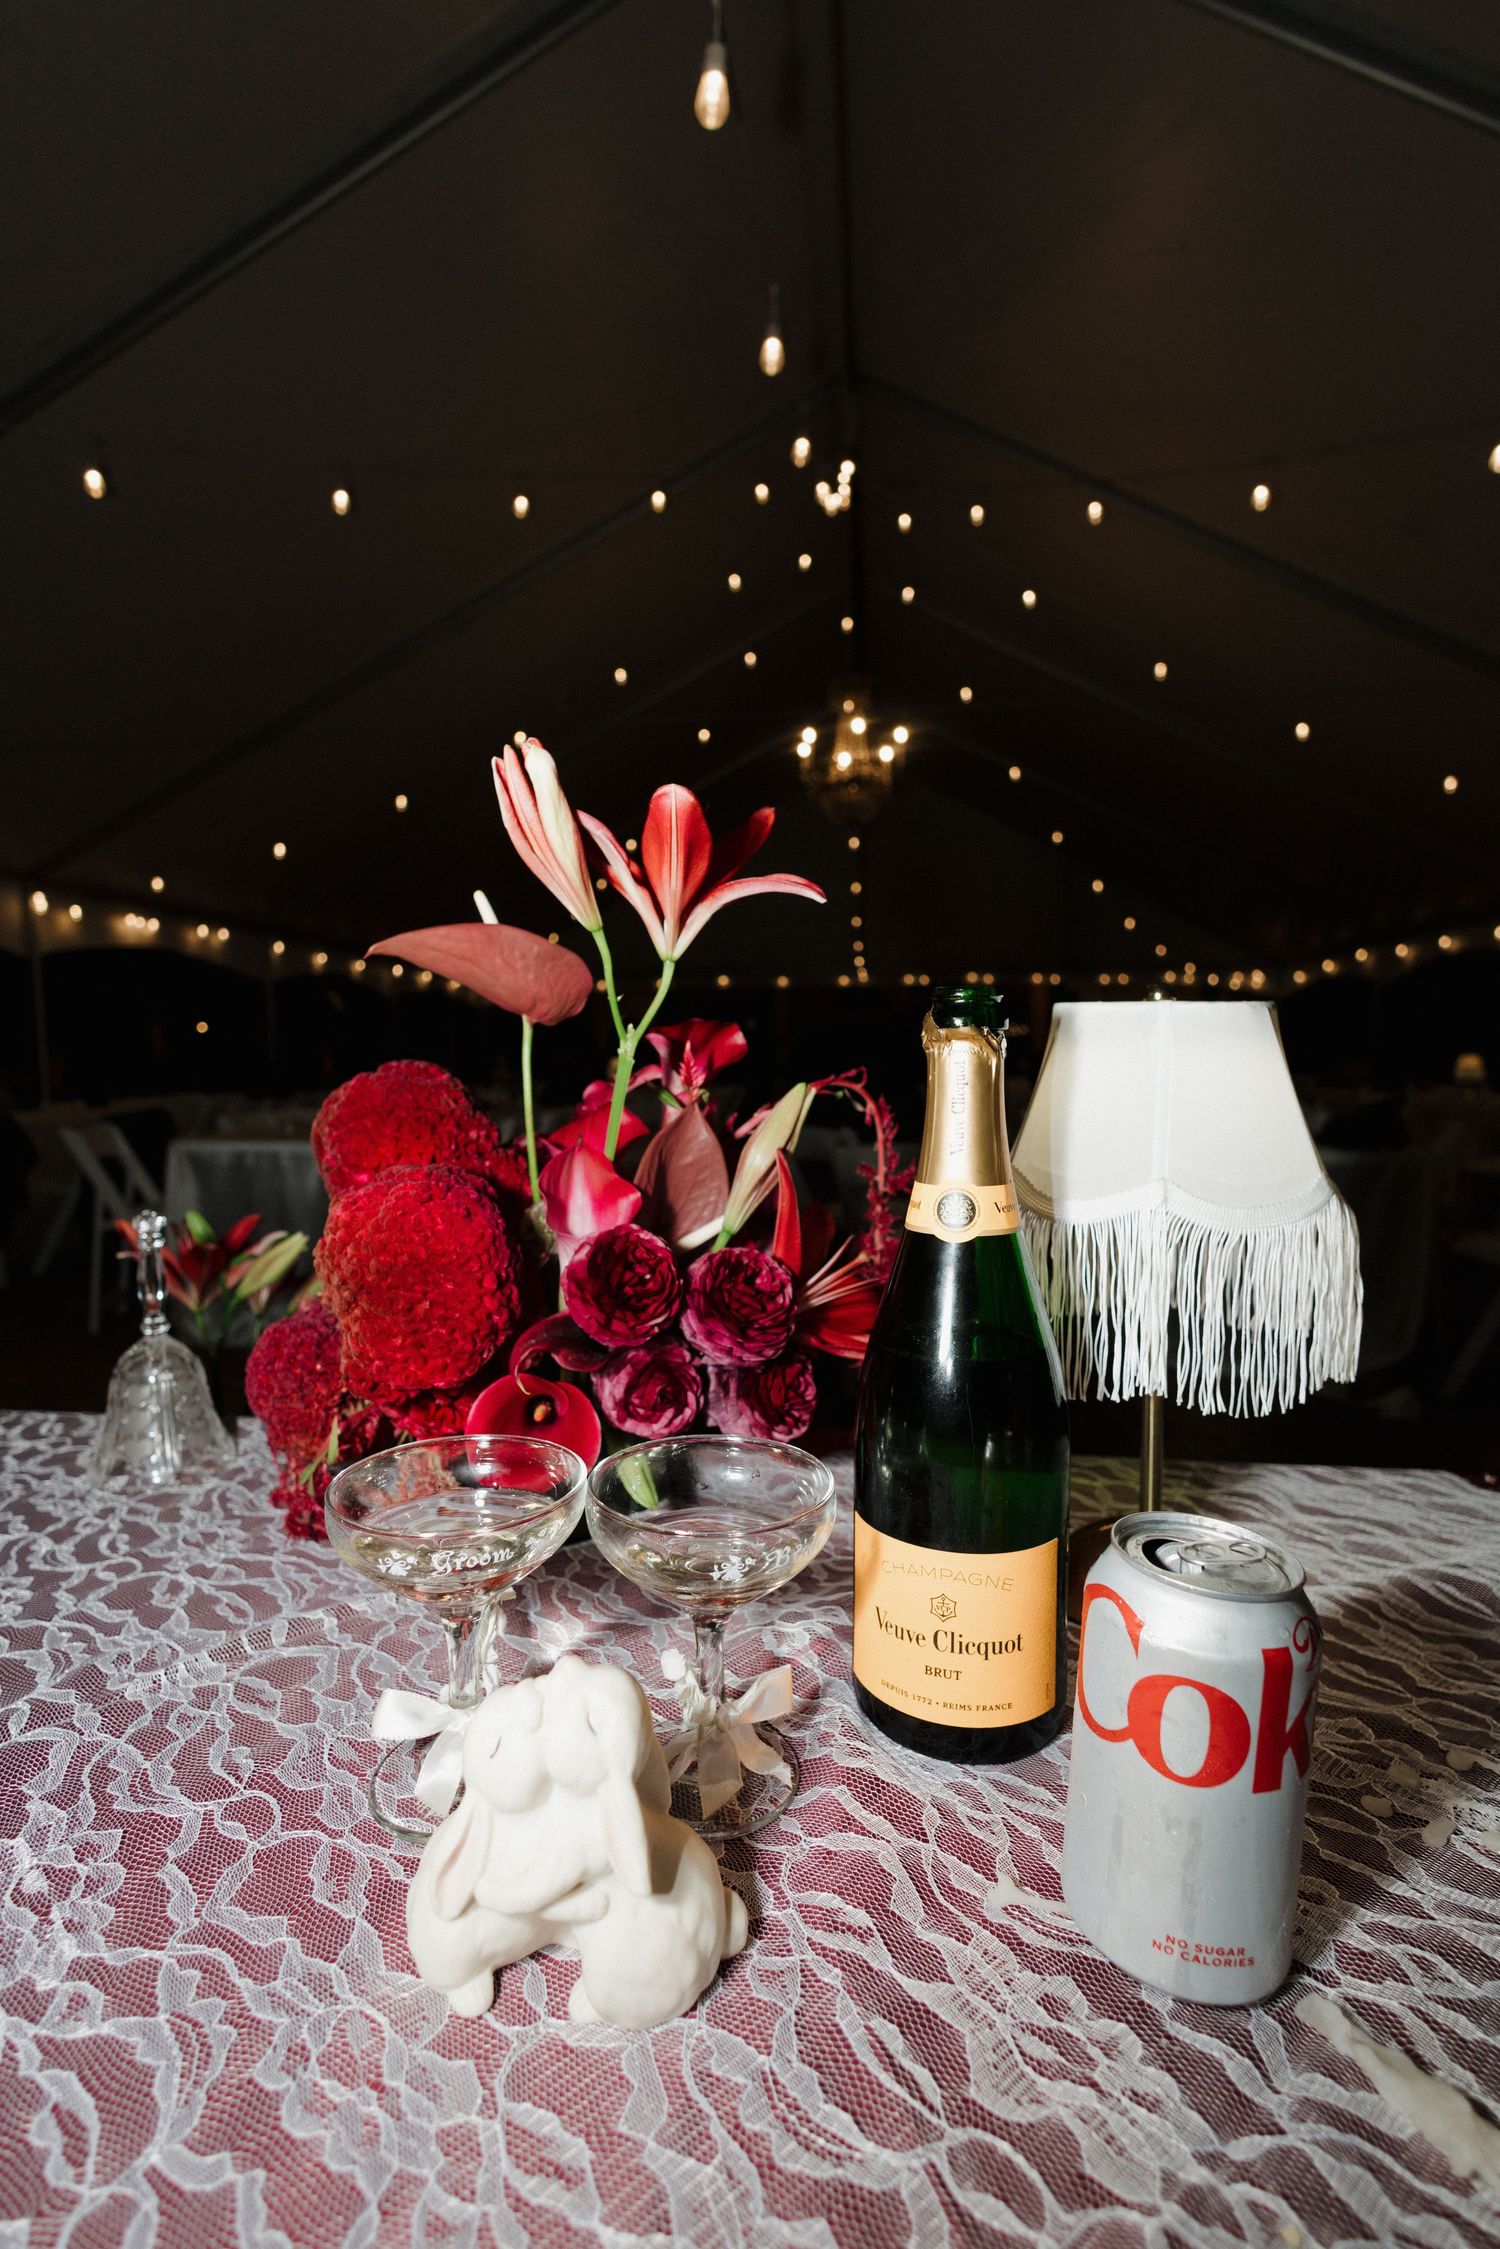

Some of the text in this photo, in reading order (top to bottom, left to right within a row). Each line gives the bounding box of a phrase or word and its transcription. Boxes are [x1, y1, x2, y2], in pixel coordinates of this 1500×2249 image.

[951, 1060, 968, 1156] Veuve Clicquot
[431, 1547, 515, 1577] Groom
[880, 1559, 1015, 1592] CHAMPAGNE
[875, 1605, 1024, 1661] Veuve Clicquot
[924, 1664, 963, 1681] BRUT
[1076, 1583, 1311, 1794] Cok
[880, 1678, 1014, 1712] DEPUIS 1772 REIMS FRANCE
[1151, 1938, 1256, 1968] NO CALORIES
[1165, 1933, 1247, 1957] NO SUGAR
